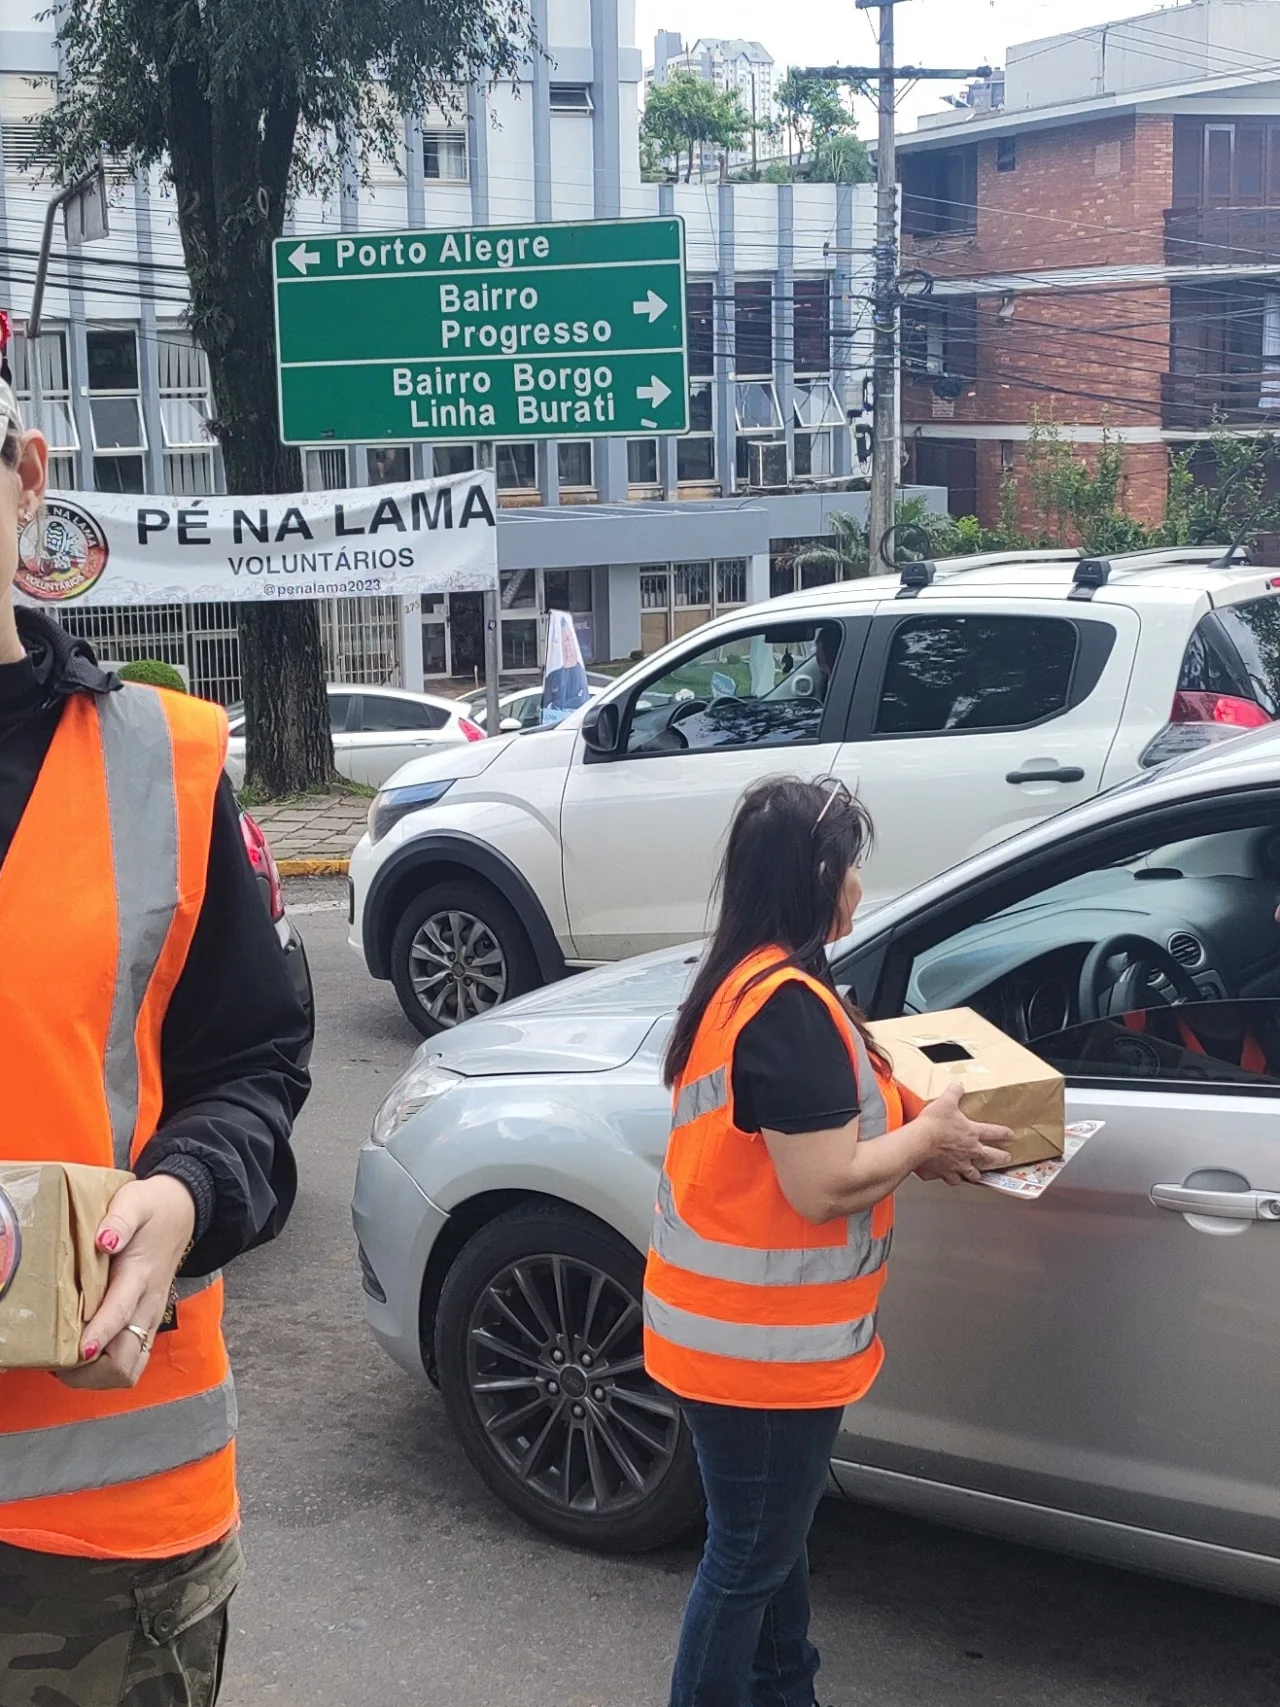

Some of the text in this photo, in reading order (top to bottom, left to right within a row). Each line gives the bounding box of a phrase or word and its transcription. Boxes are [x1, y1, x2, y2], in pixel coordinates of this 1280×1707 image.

[336, 233, 550, 269] Porto Alegre
[439, 283, 539, 313] Bairro
[441, 319, 612, 355] Progresso
[393, 363, 613, 398] Bairro Borgo
[410, 392, 616, 428] Linha Burati
[53, 506, 71, 520] NA
[72, 516, 97, 547] LAMA
[137, 485, 497, 545] PÉ NA LAMA
[228, 546, 415, 576] VOLUNTÁRIOS
[263, 578, 382, 597] @penalama2023
